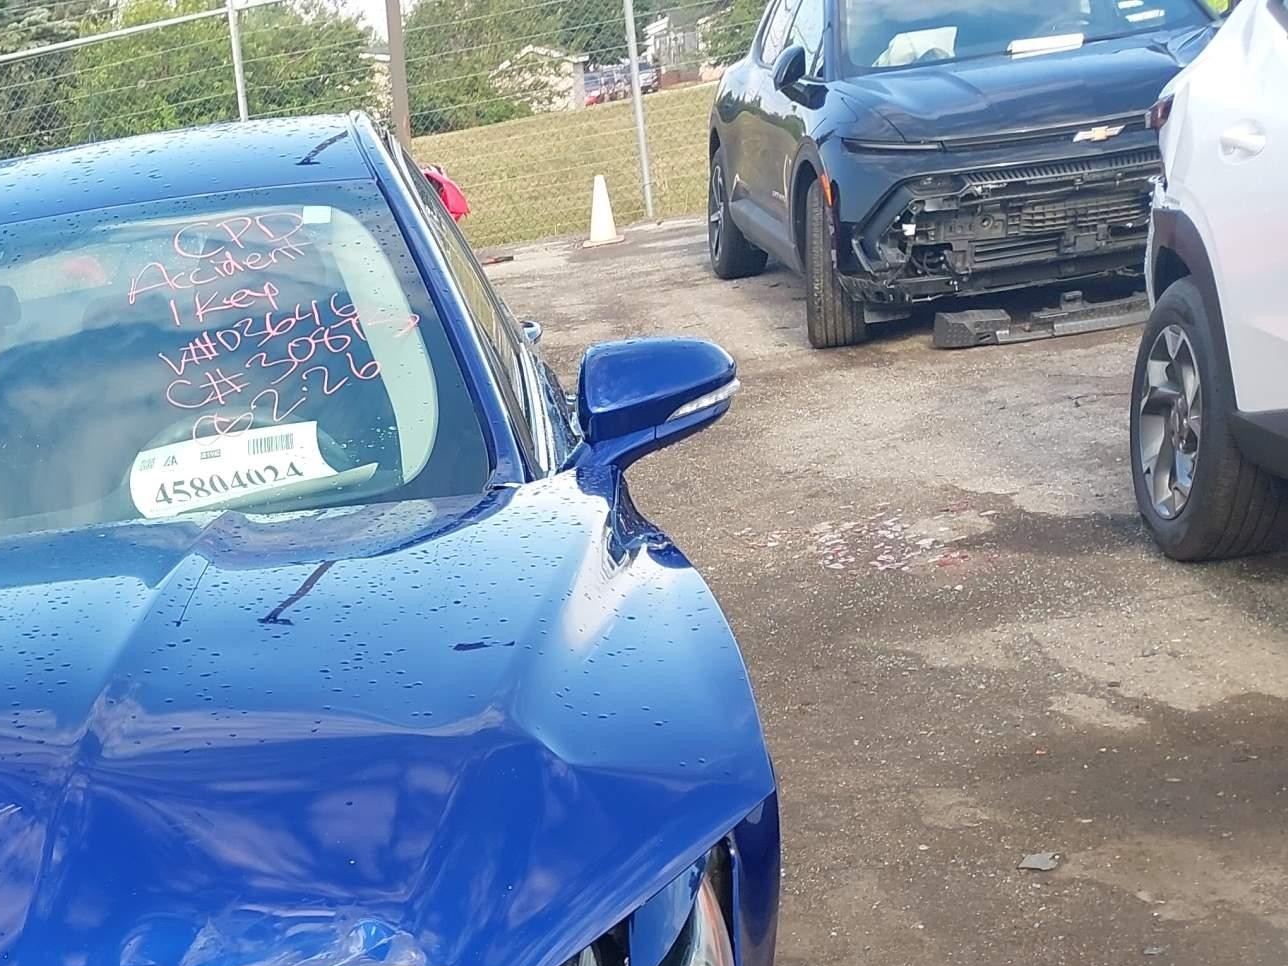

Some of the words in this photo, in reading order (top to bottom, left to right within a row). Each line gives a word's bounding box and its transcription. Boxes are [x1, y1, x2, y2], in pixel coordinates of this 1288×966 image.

[174, 212, 304, 259] CPD
[127, 241, 313, 305] Accident
[155, 462, 305, 505] 45804024
